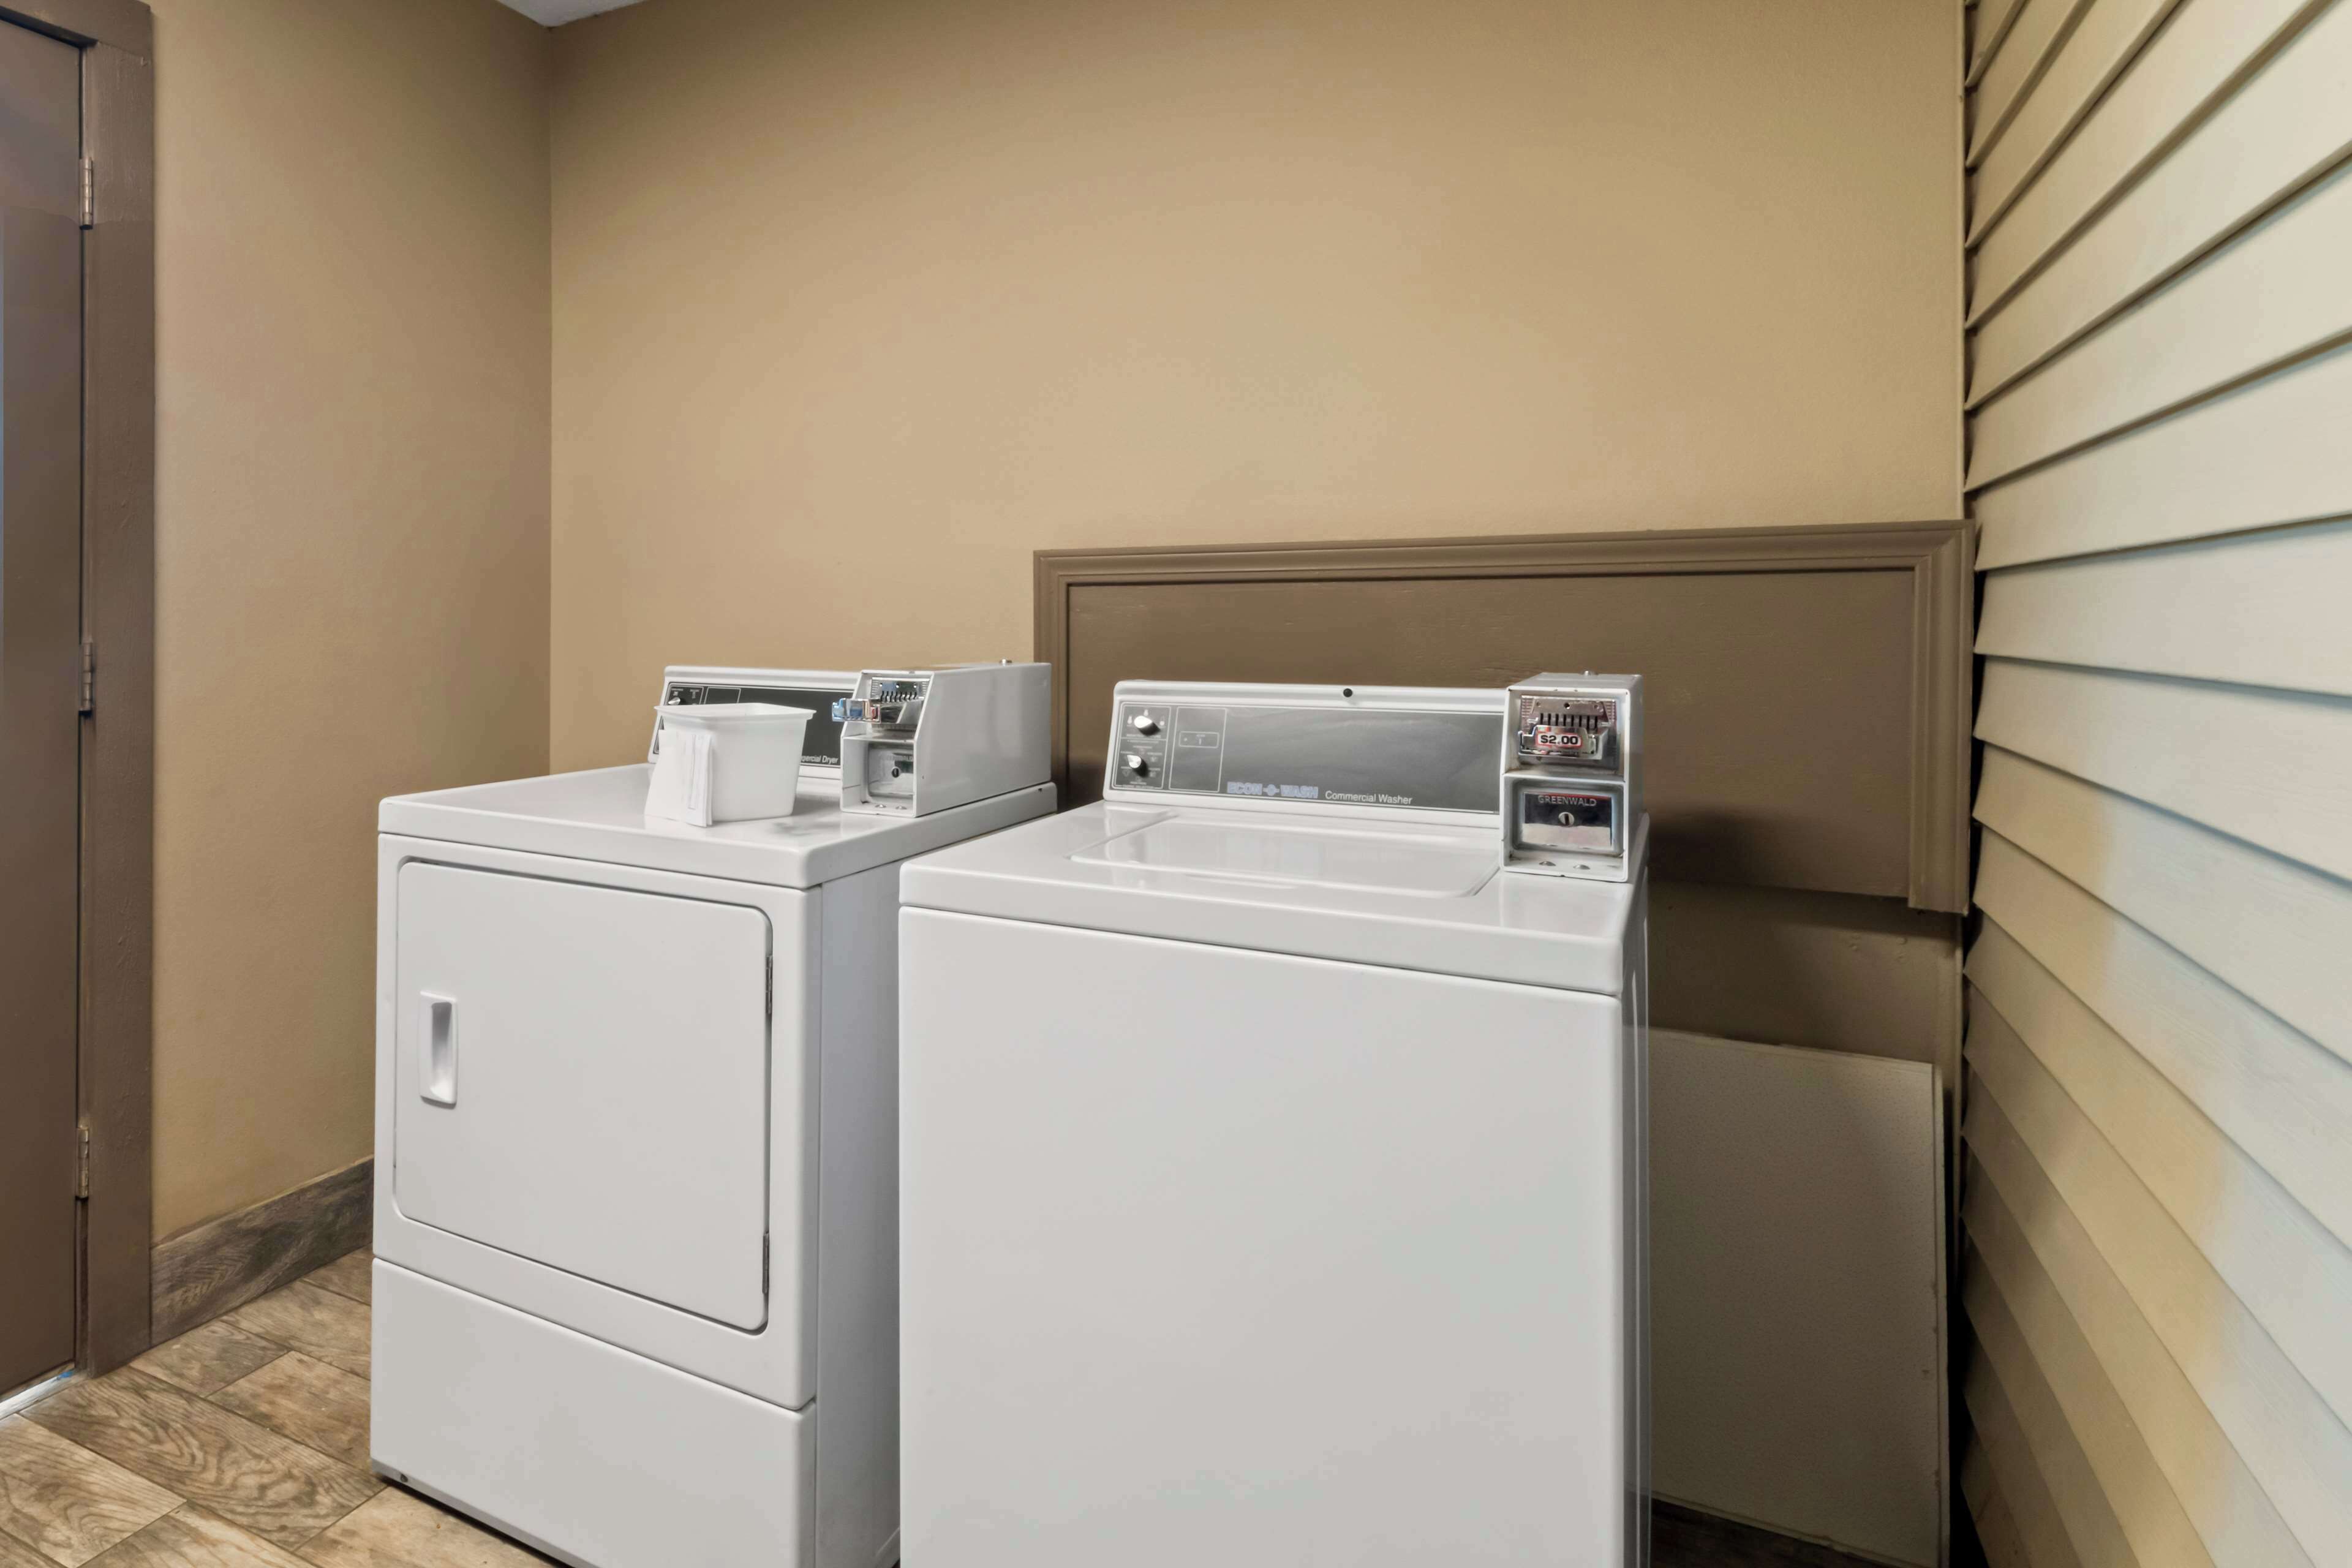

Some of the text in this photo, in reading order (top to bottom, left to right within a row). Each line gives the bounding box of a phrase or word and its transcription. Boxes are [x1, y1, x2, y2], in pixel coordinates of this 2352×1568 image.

[822, 755, 839, 765] Dryer
[1325, 790, 1413, 805] Commercial Washer
[1537, 794, 1597, 807] GREENWALD
